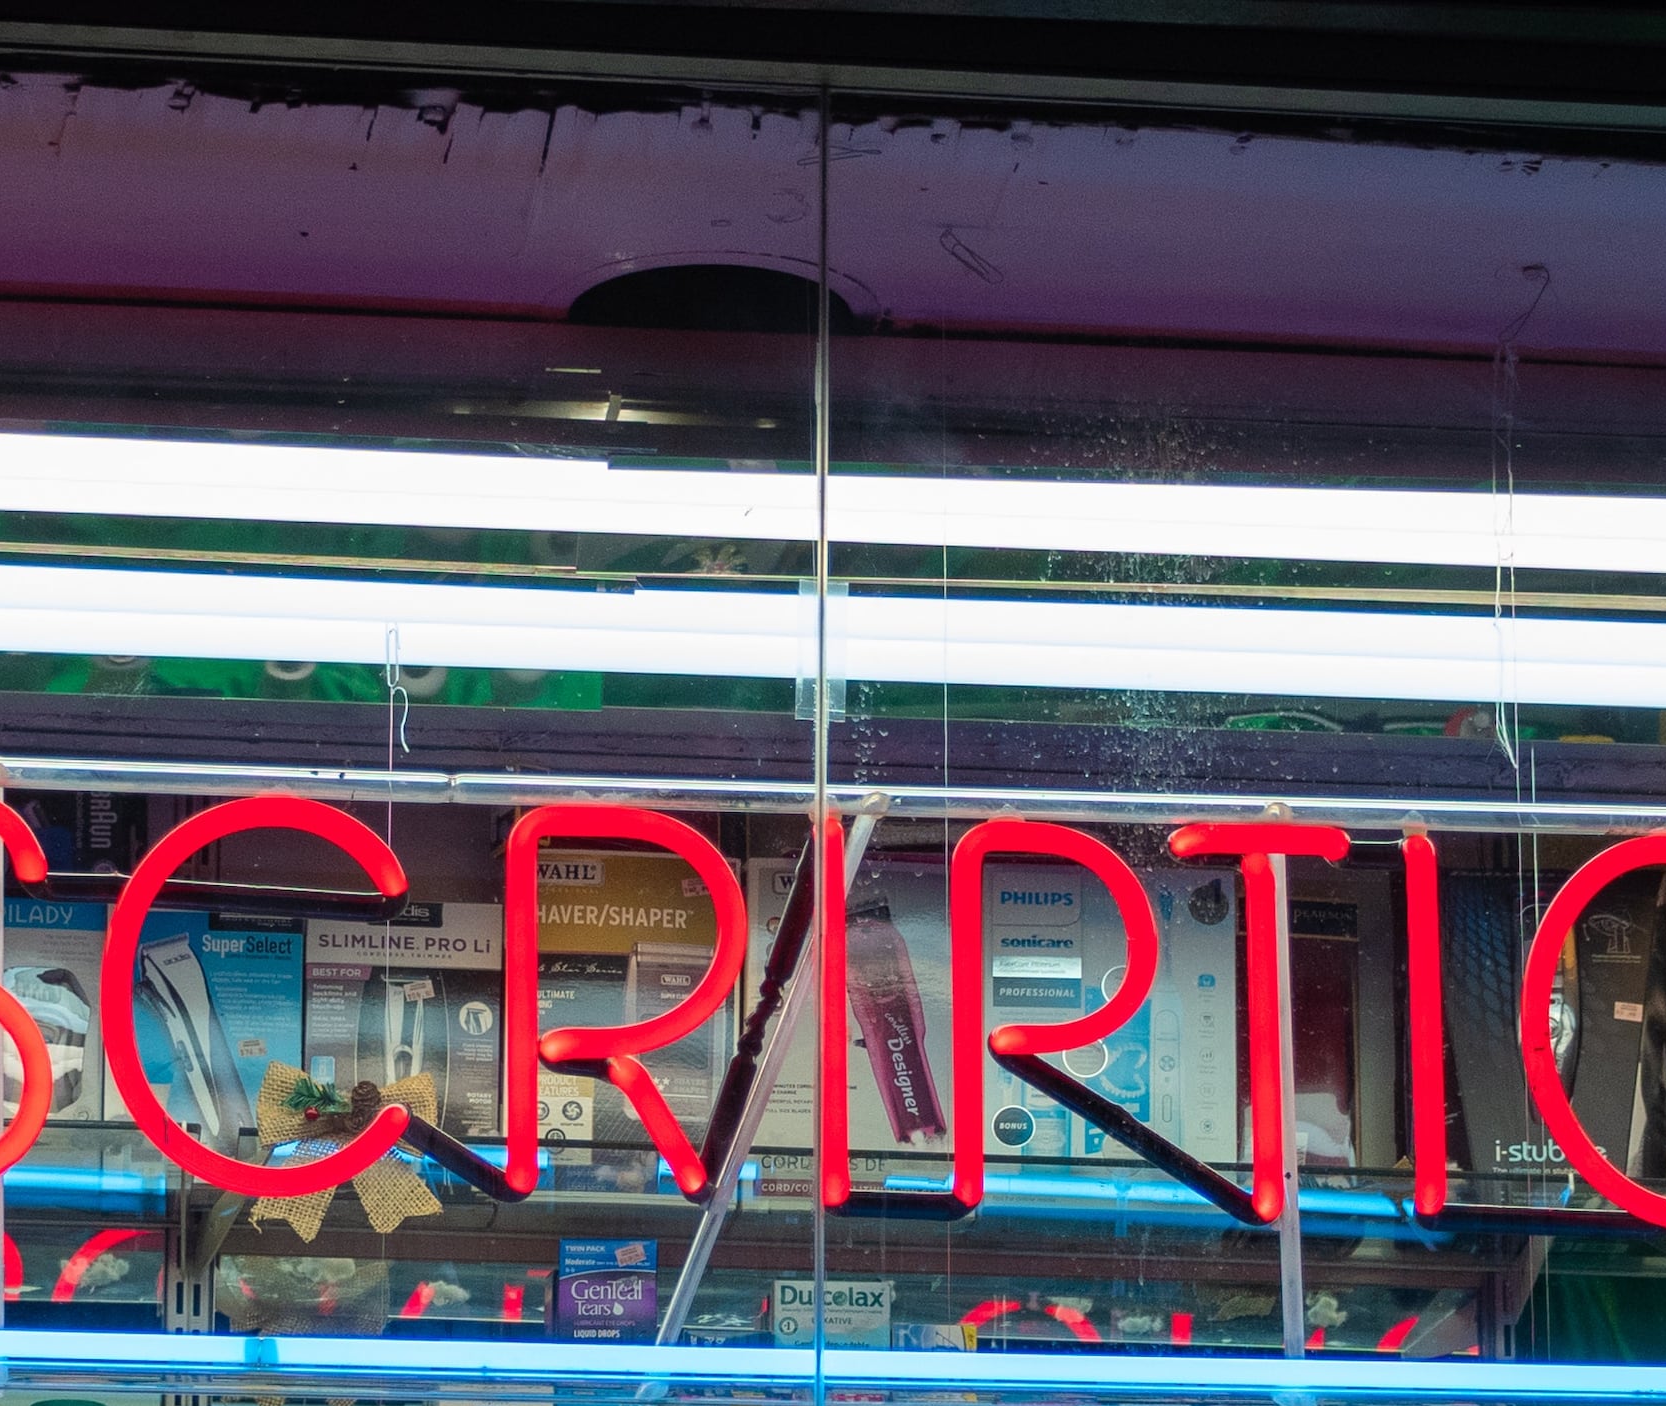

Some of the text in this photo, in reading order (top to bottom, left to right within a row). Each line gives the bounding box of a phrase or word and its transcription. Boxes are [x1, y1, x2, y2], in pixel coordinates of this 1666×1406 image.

[1000, 891, 1074, 907] PHILIPS
[202, 935, 293, 957] SuperSelect
[425, 937, 467, 952] PRO
[1000, 935, 1074, 950] sonicare
[312, 967, 362, 977] BEST FOR
[998, 987, 1076, 999] PROFESSIONAL
[886, 1037, 921, 1118] Designer
[998, 1122, 1028, 1131] BONUS
[574, 1301, 613, 1317] Tears
